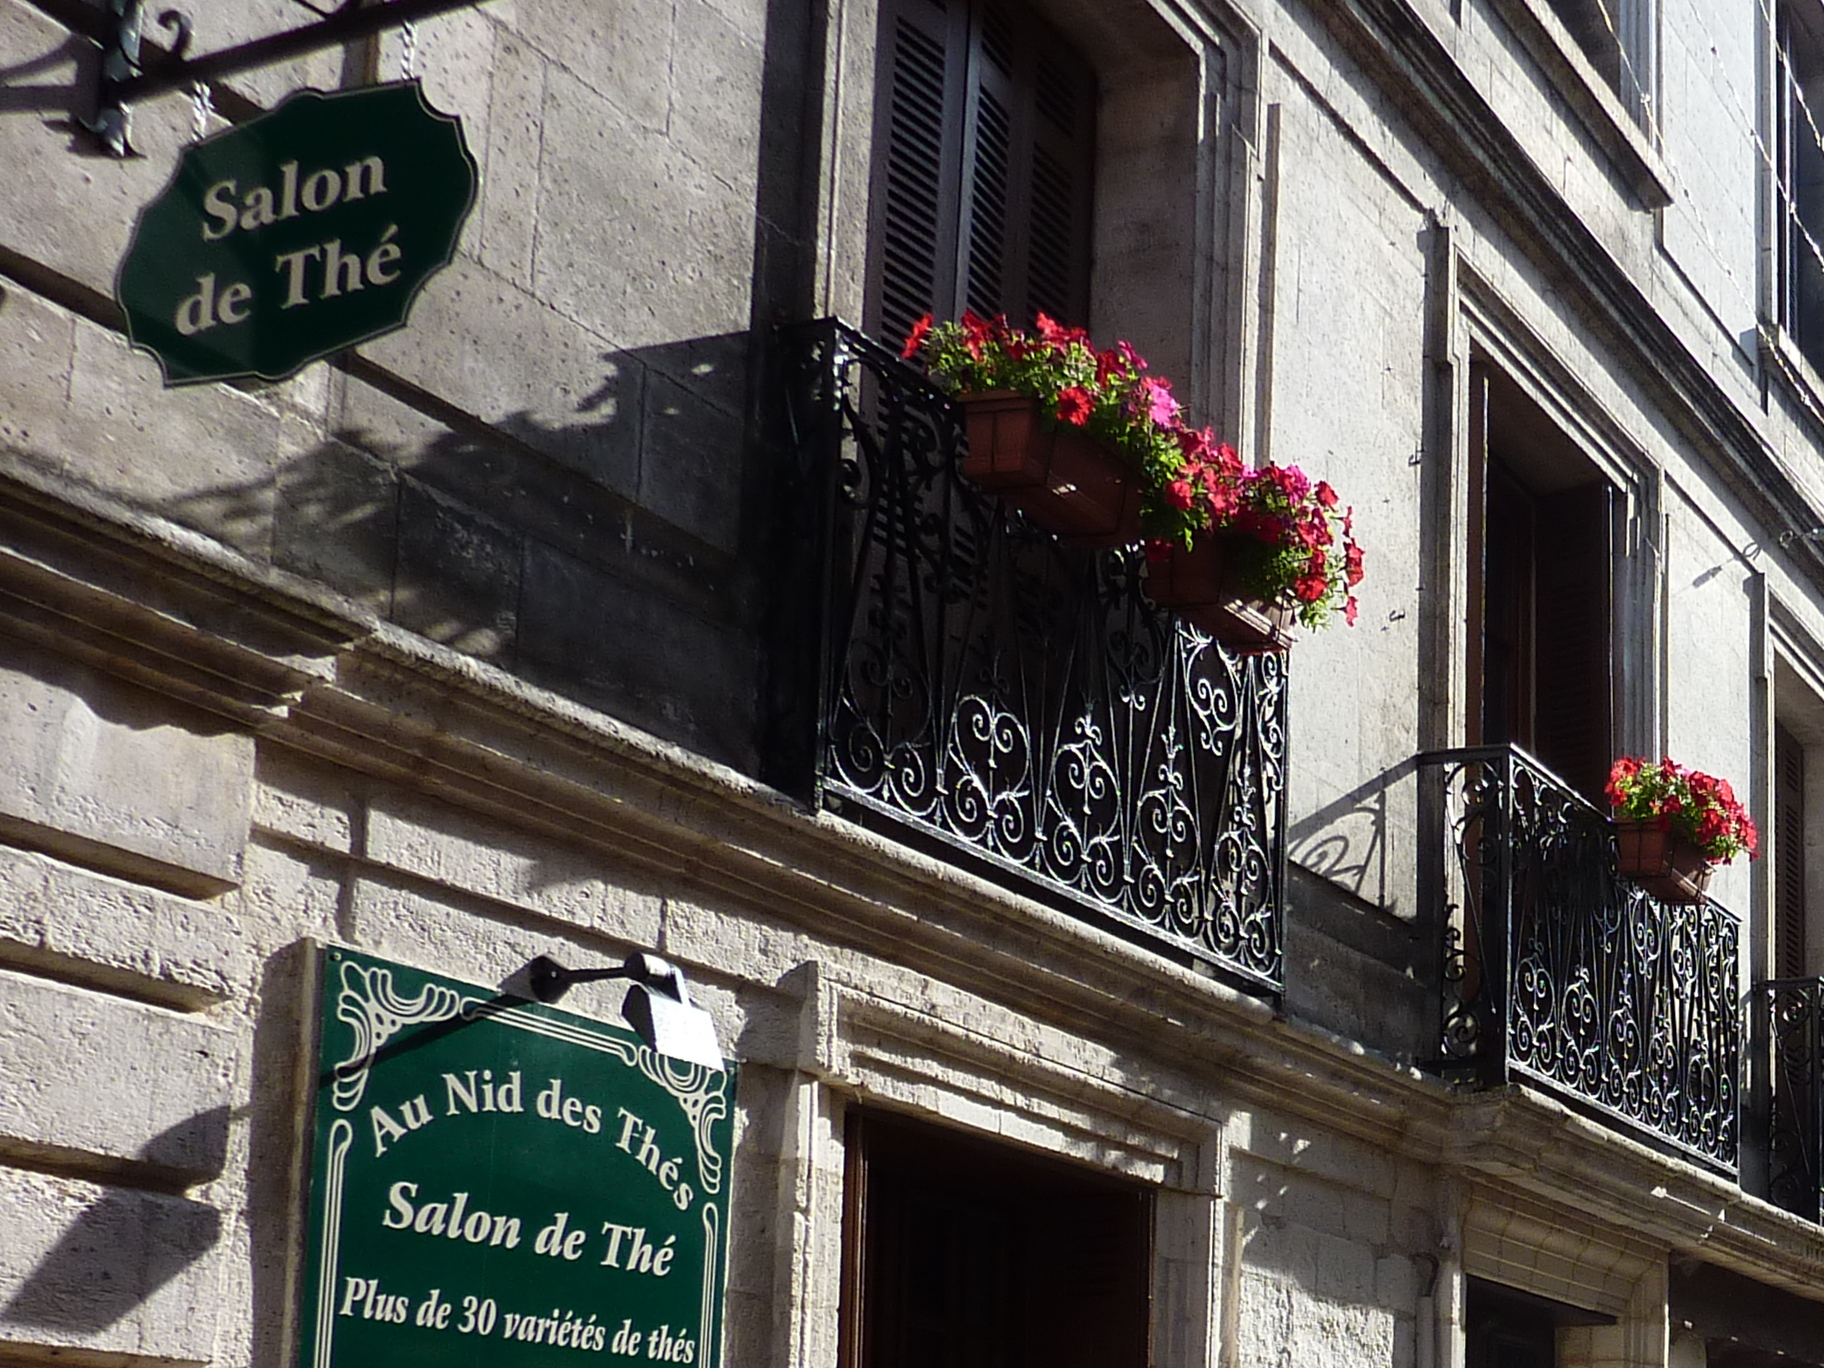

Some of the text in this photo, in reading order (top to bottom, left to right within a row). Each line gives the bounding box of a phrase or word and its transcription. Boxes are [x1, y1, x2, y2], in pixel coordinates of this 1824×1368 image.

[202, 156, 387, 242] Salon
[175, 224, 402, 335] de Thé
[369, 1069, 695, 1212] Au Nid des Thés
[382, 1181, 676, 1277] Salon de Thé
[339, 1276, 696, 1364] Plus de 30 variétés de thés
